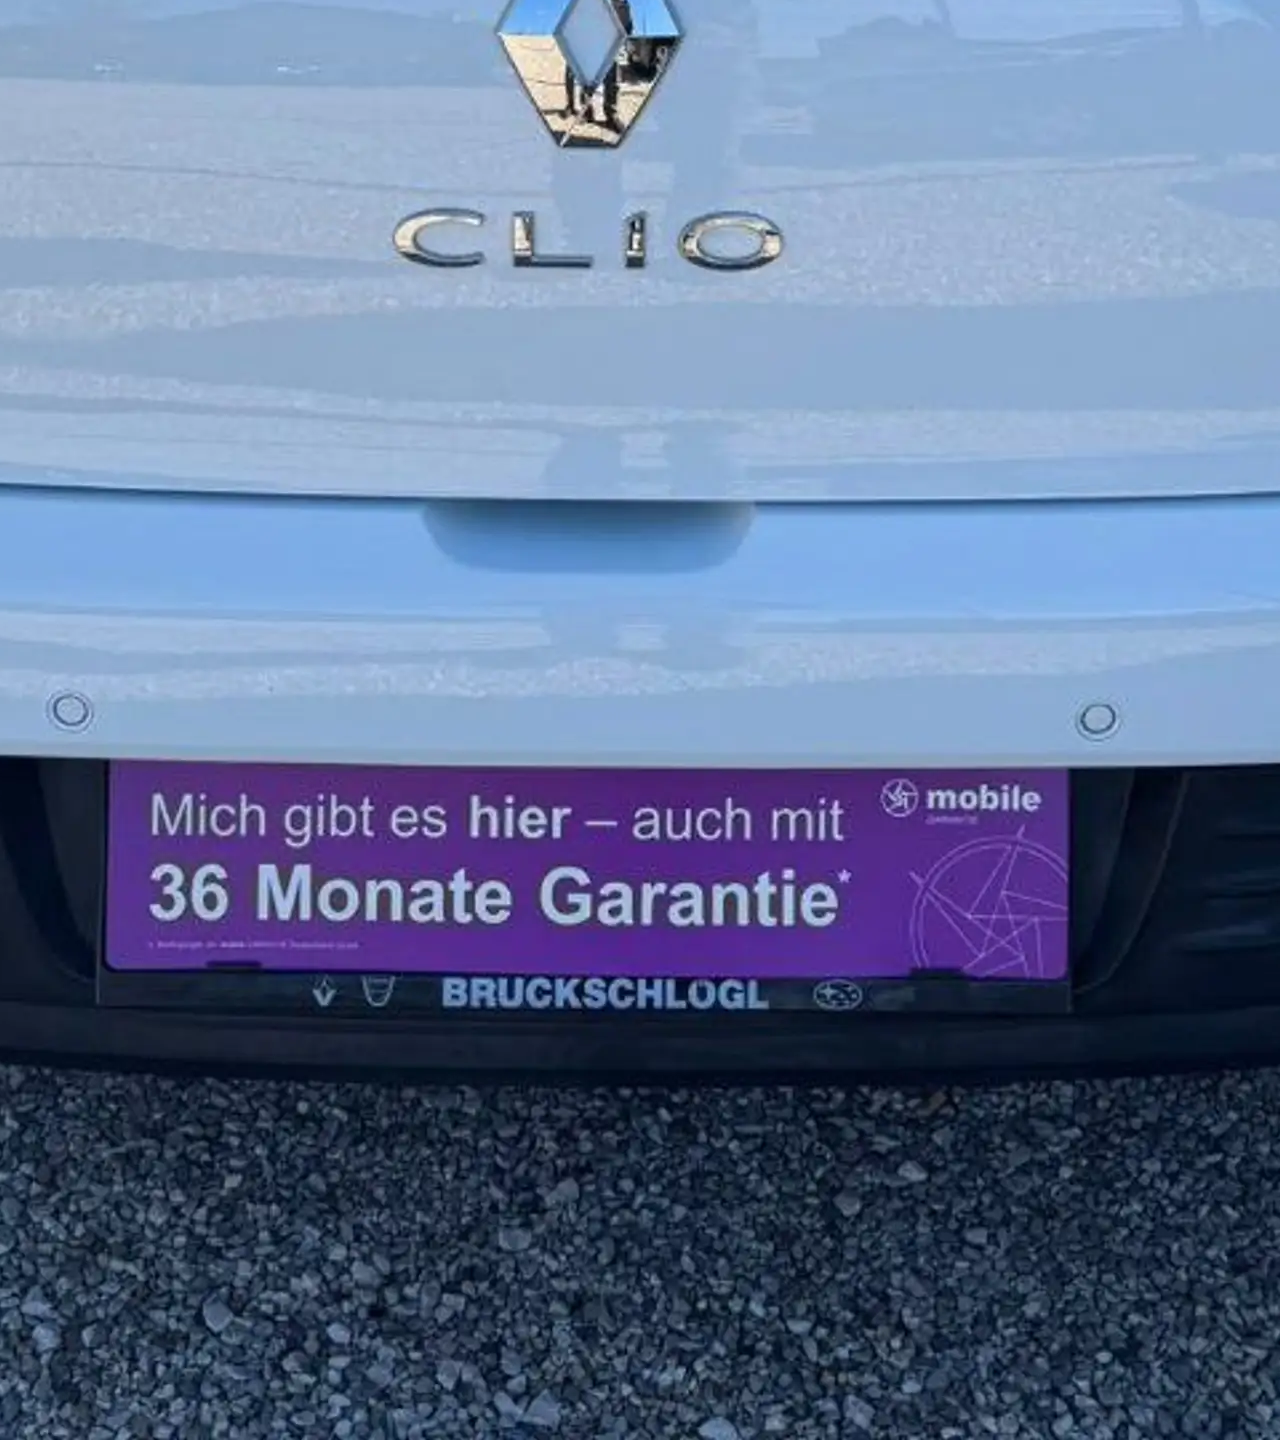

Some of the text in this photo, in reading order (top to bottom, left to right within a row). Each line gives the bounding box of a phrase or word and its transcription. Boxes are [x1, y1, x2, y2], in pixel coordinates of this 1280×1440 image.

[393, 208, 786, 271] CLIO
[150, 792, 267, 838] Mich
[283, 793, 376, 849] gibt
[390, 804, 448, 839] es
[470, 794, 573, 839] hier
[632, 796, 753, 842] auch
[772, 796, 845, 842] mit
[926, 783, 1043, 812] mobile
[149, 863, 230, 921] 36
[256, 863, 513, 925] Monate
